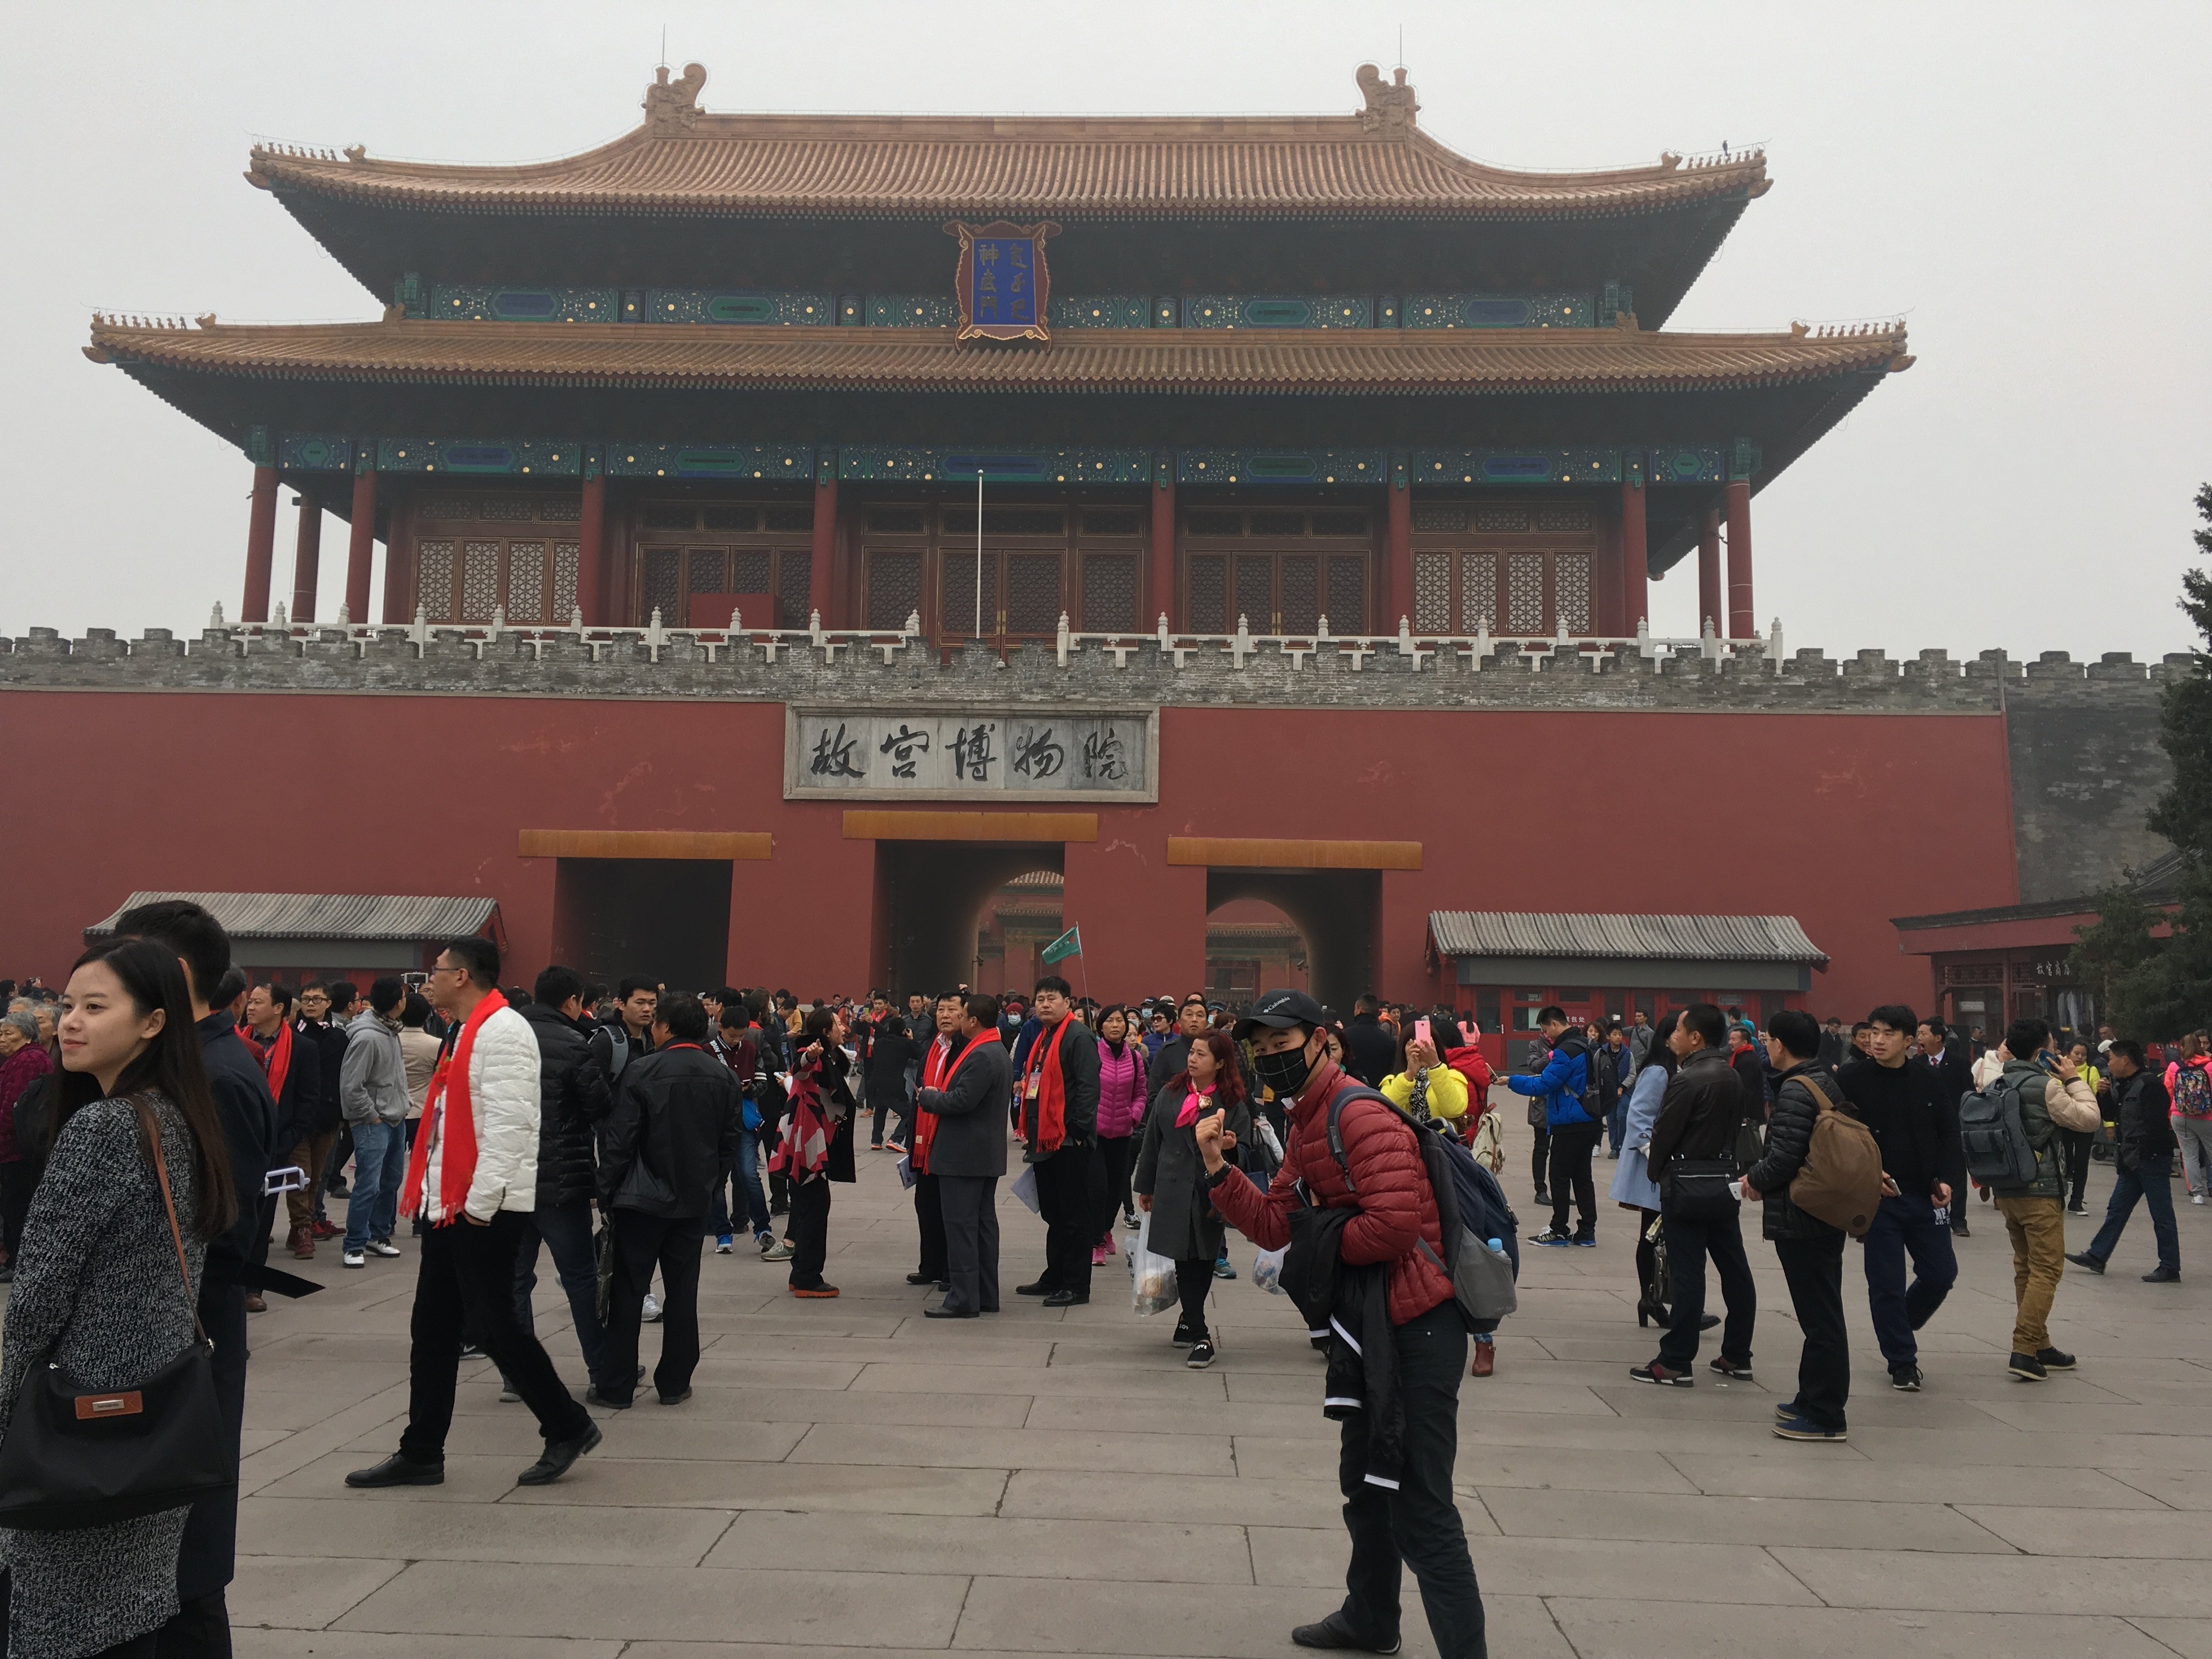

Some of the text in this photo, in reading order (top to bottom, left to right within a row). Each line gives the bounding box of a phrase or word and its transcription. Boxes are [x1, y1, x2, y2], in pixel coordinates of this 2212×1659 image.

[979, 242, 1000, 320] 神武門
[810, 723, 1127, 782] 故宫博物院
[1268, 996, 1290, 1011] Columbia
